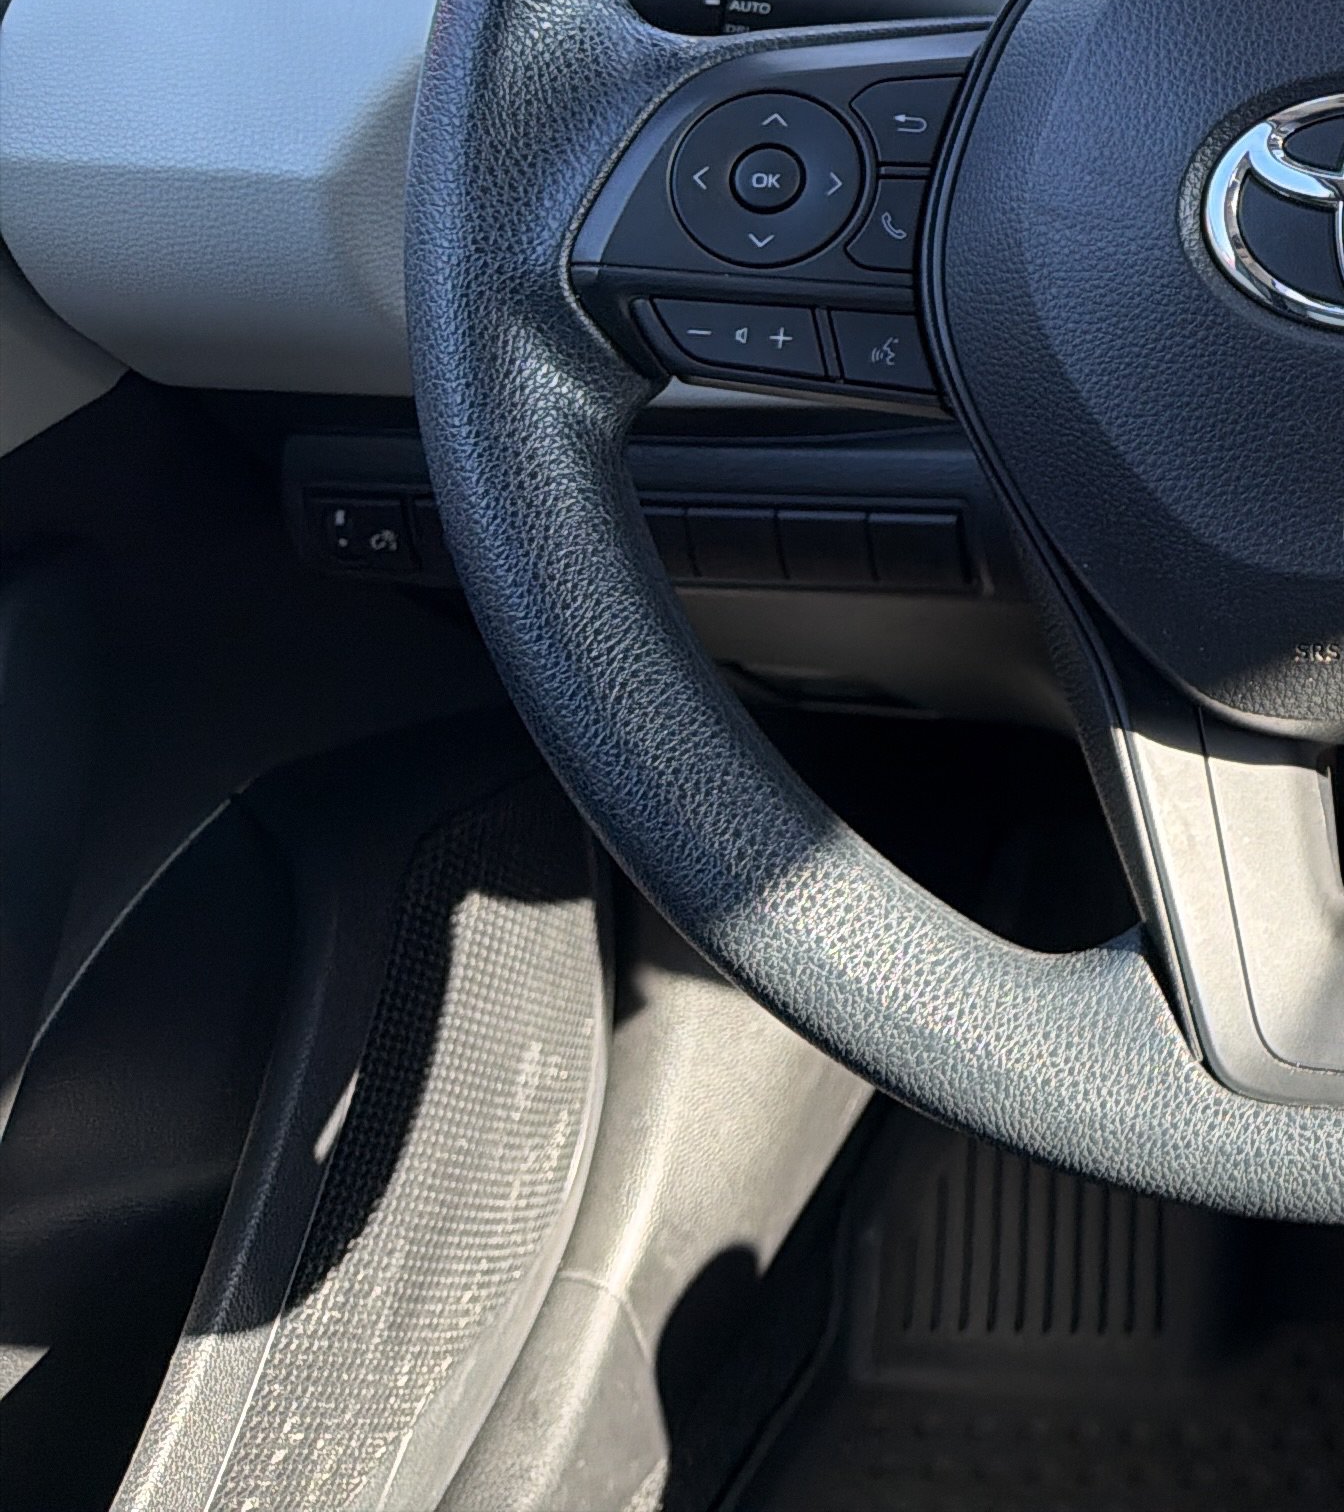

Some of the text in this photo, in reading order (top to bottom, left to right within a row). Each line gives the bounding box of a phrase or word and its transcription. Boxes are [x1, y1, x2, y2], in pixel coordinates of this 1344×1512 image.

[729, 0, 772, 15] AUTO
[751, 172, 781, 188] OK
[1294, 643, 1341, 664] SRS
